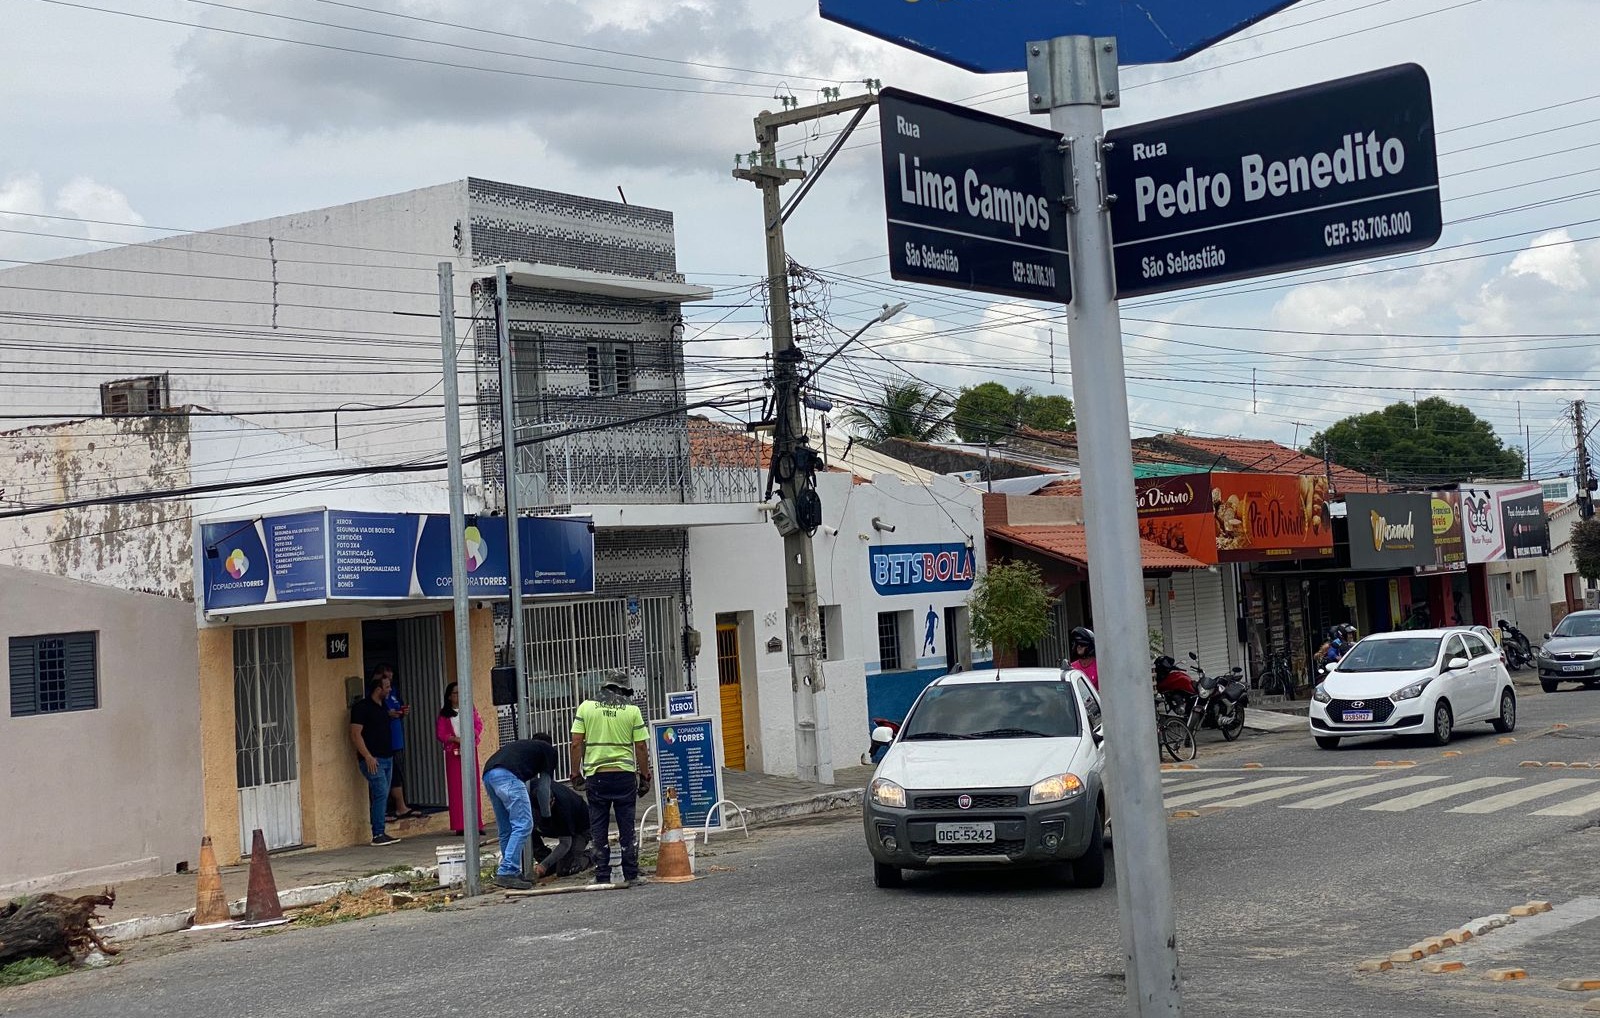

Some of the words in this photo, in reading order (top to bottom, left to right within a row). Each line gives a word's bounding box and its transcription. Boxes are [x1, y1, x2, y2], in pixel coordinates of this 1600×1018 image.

[896, 115, 920, 139] Rua
[1132, 141, 1168, 161] Rua
[1135, 167, 1231, 223] Pedro
[1241, 130, 1405, 202] Benedito
[899, 153, 959, 213] Lima
[963, 168, 1050, 237] Campos
[1324, 224, 1350, 247] CEP:
[1352, 211, 1412, 242] 58.706.000
[905, 241, 921, 267] São
[922, 244, 959, 273] Sebastião
[1141, 257, 1164, 279] São
[1166, 245, 1226, 273] Sebastião
[1012, 261, 1025, 282] CEP:
[1026, 263, 1056, 288] 58.706.310
[1146, 487, 1189, 507] Divino
[1248, 500, 1269, 539] Pão
[336, 533, 363, 541] CERTIDÕES
[336, 549, 374, 557] PLASTIFICAÇÃO
[336, 557, 377, 565] ENCADERNAÇÃO
[873, 551, 974, 586] BETSBOLA
[337, 580, 354, 588] BONÉS
[331, 638, 347, 654] 196
[670, 702, 694, 713] XEROX
[677, 734, 705, 743] TORRES
